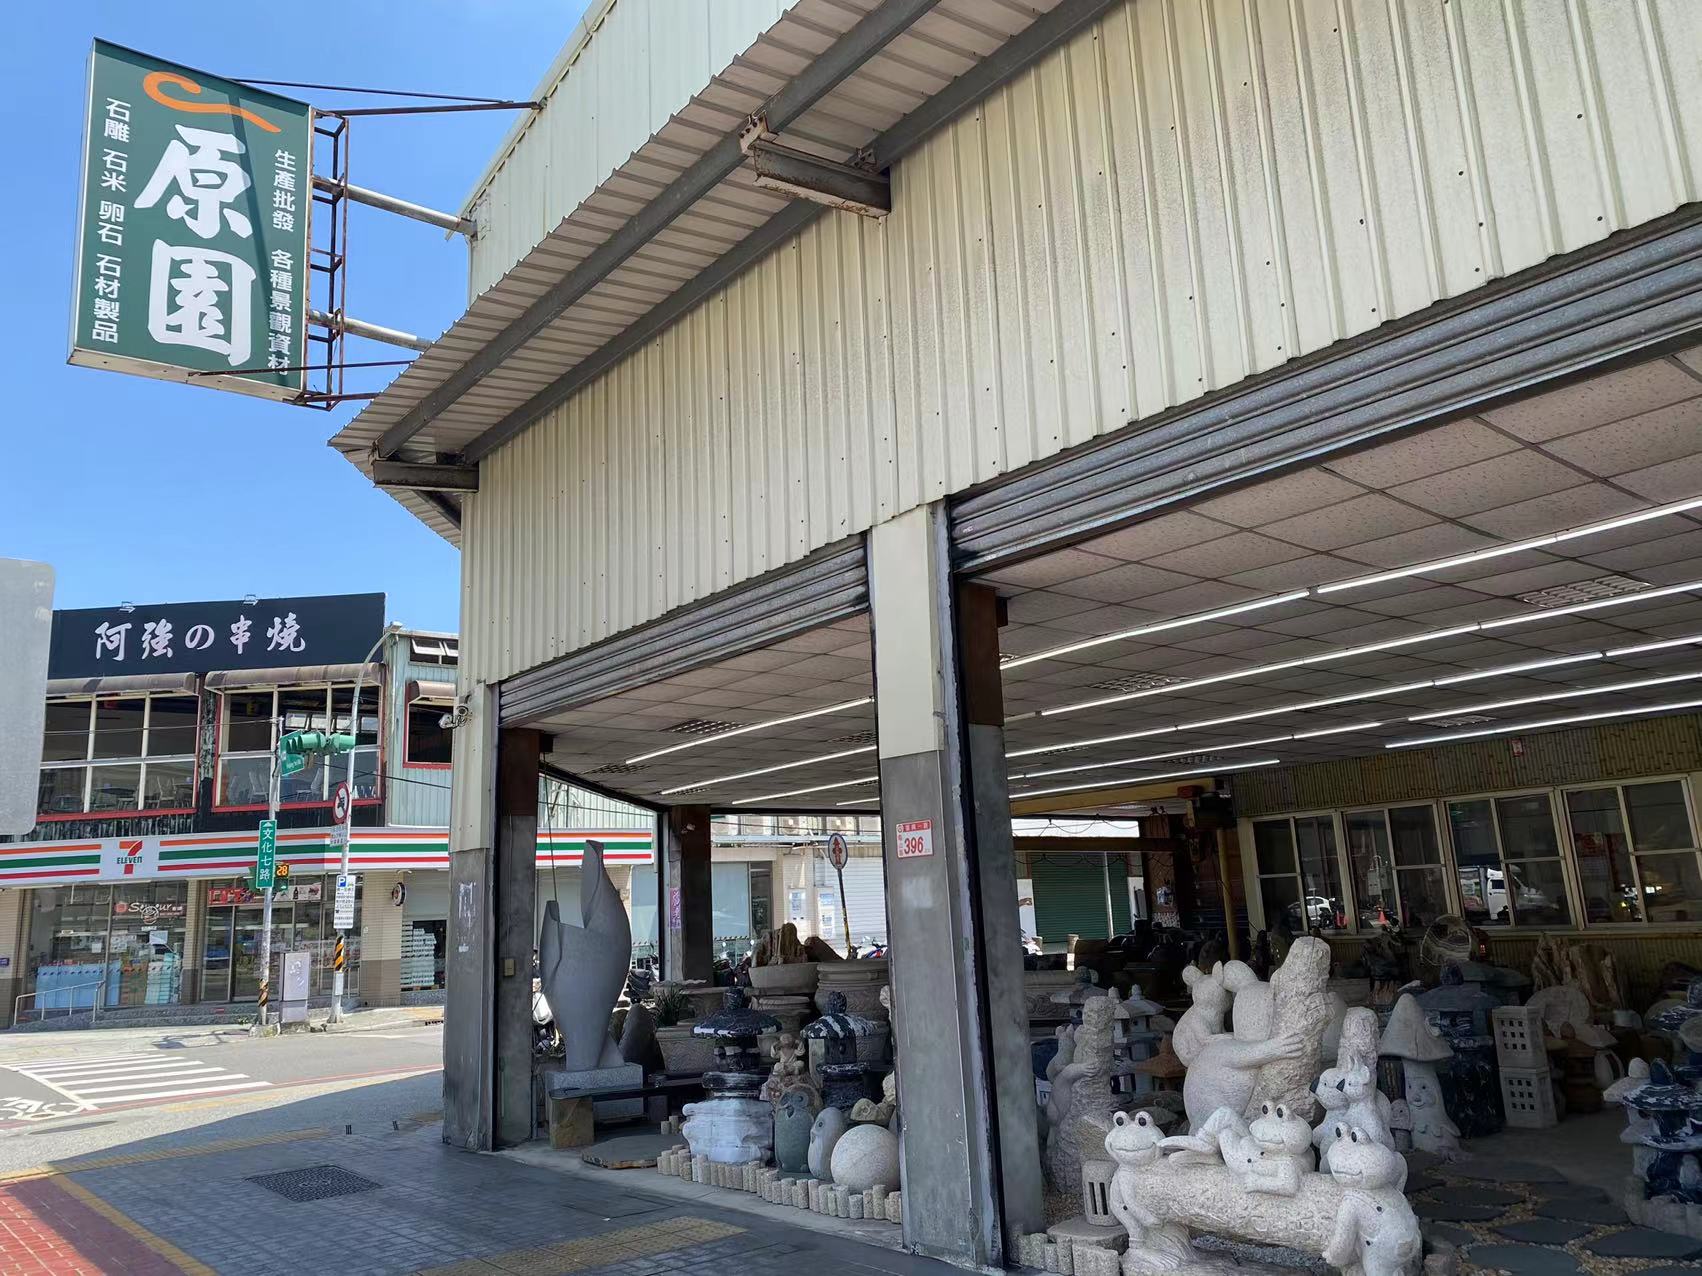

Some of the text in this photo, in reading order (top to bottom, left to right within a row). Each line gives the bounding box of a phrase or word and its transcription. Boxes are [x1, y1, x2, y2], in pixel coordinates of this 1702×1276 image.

[92, 97, 131, 344] 石雕 石米 卵石 石材製品
[133, 124, 257, 367] 原園
[267, 149, 297, 376] 生產批發 各種景觀資材
[259, 828, 274, 882] 文化七路
[276, 865, 288, 876] 28
[904, 836, 924, 854] 396
